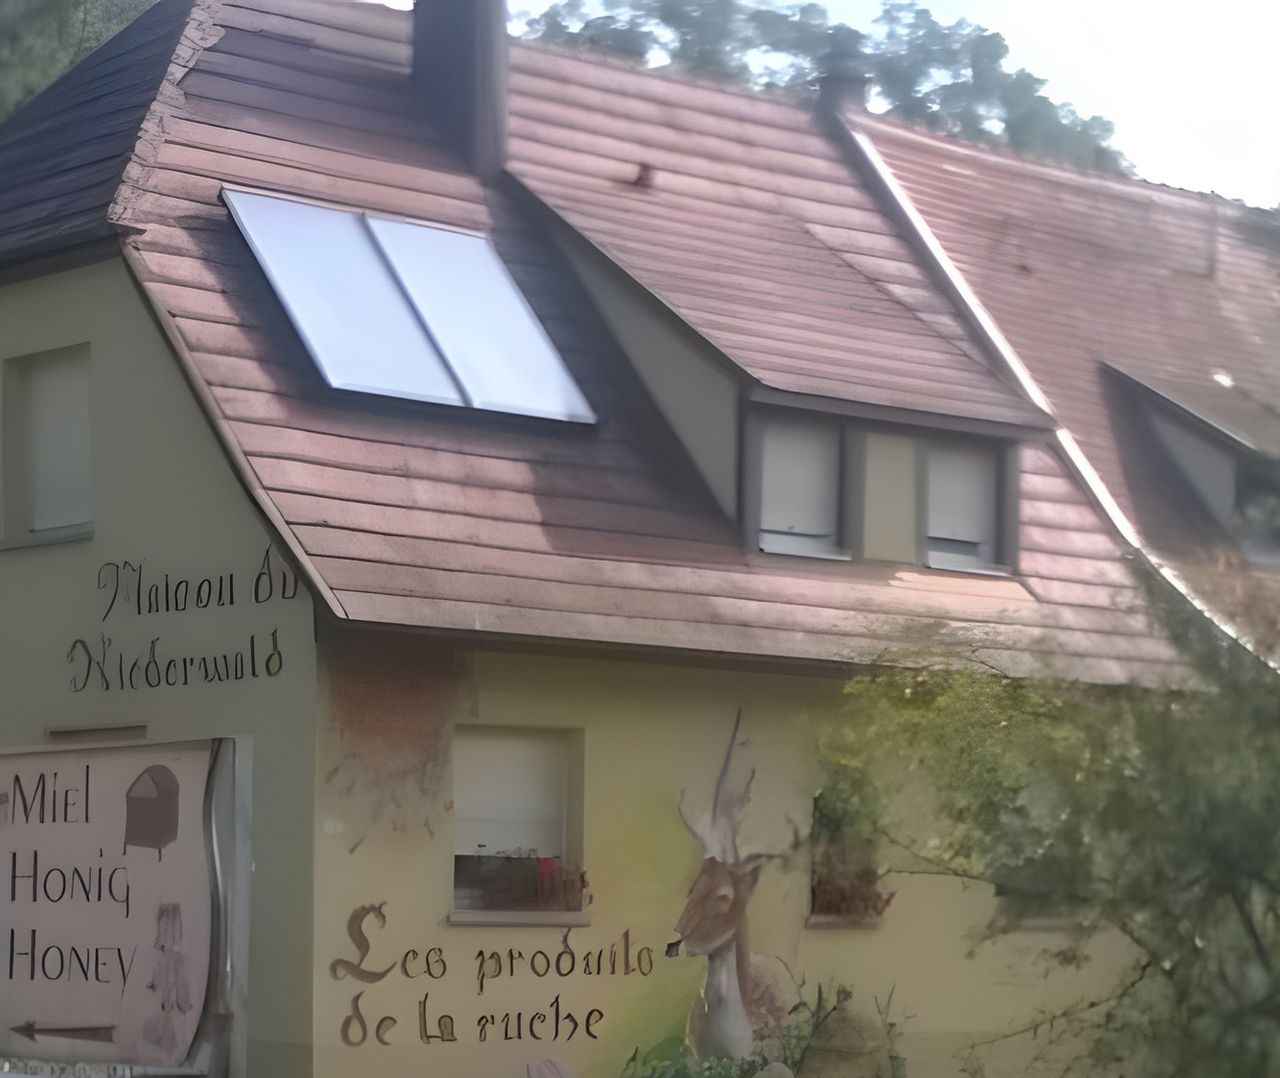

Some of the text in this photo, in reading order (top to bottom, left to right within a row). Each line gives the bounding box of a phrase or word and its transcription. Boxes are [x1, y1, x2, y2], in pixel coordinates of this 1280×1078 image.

[253, 543, 299, 604] du
[328, 901, 448, 984] Les
[340, 990, 398, 1047] de
[476, 993, 605, 1042] ruche
